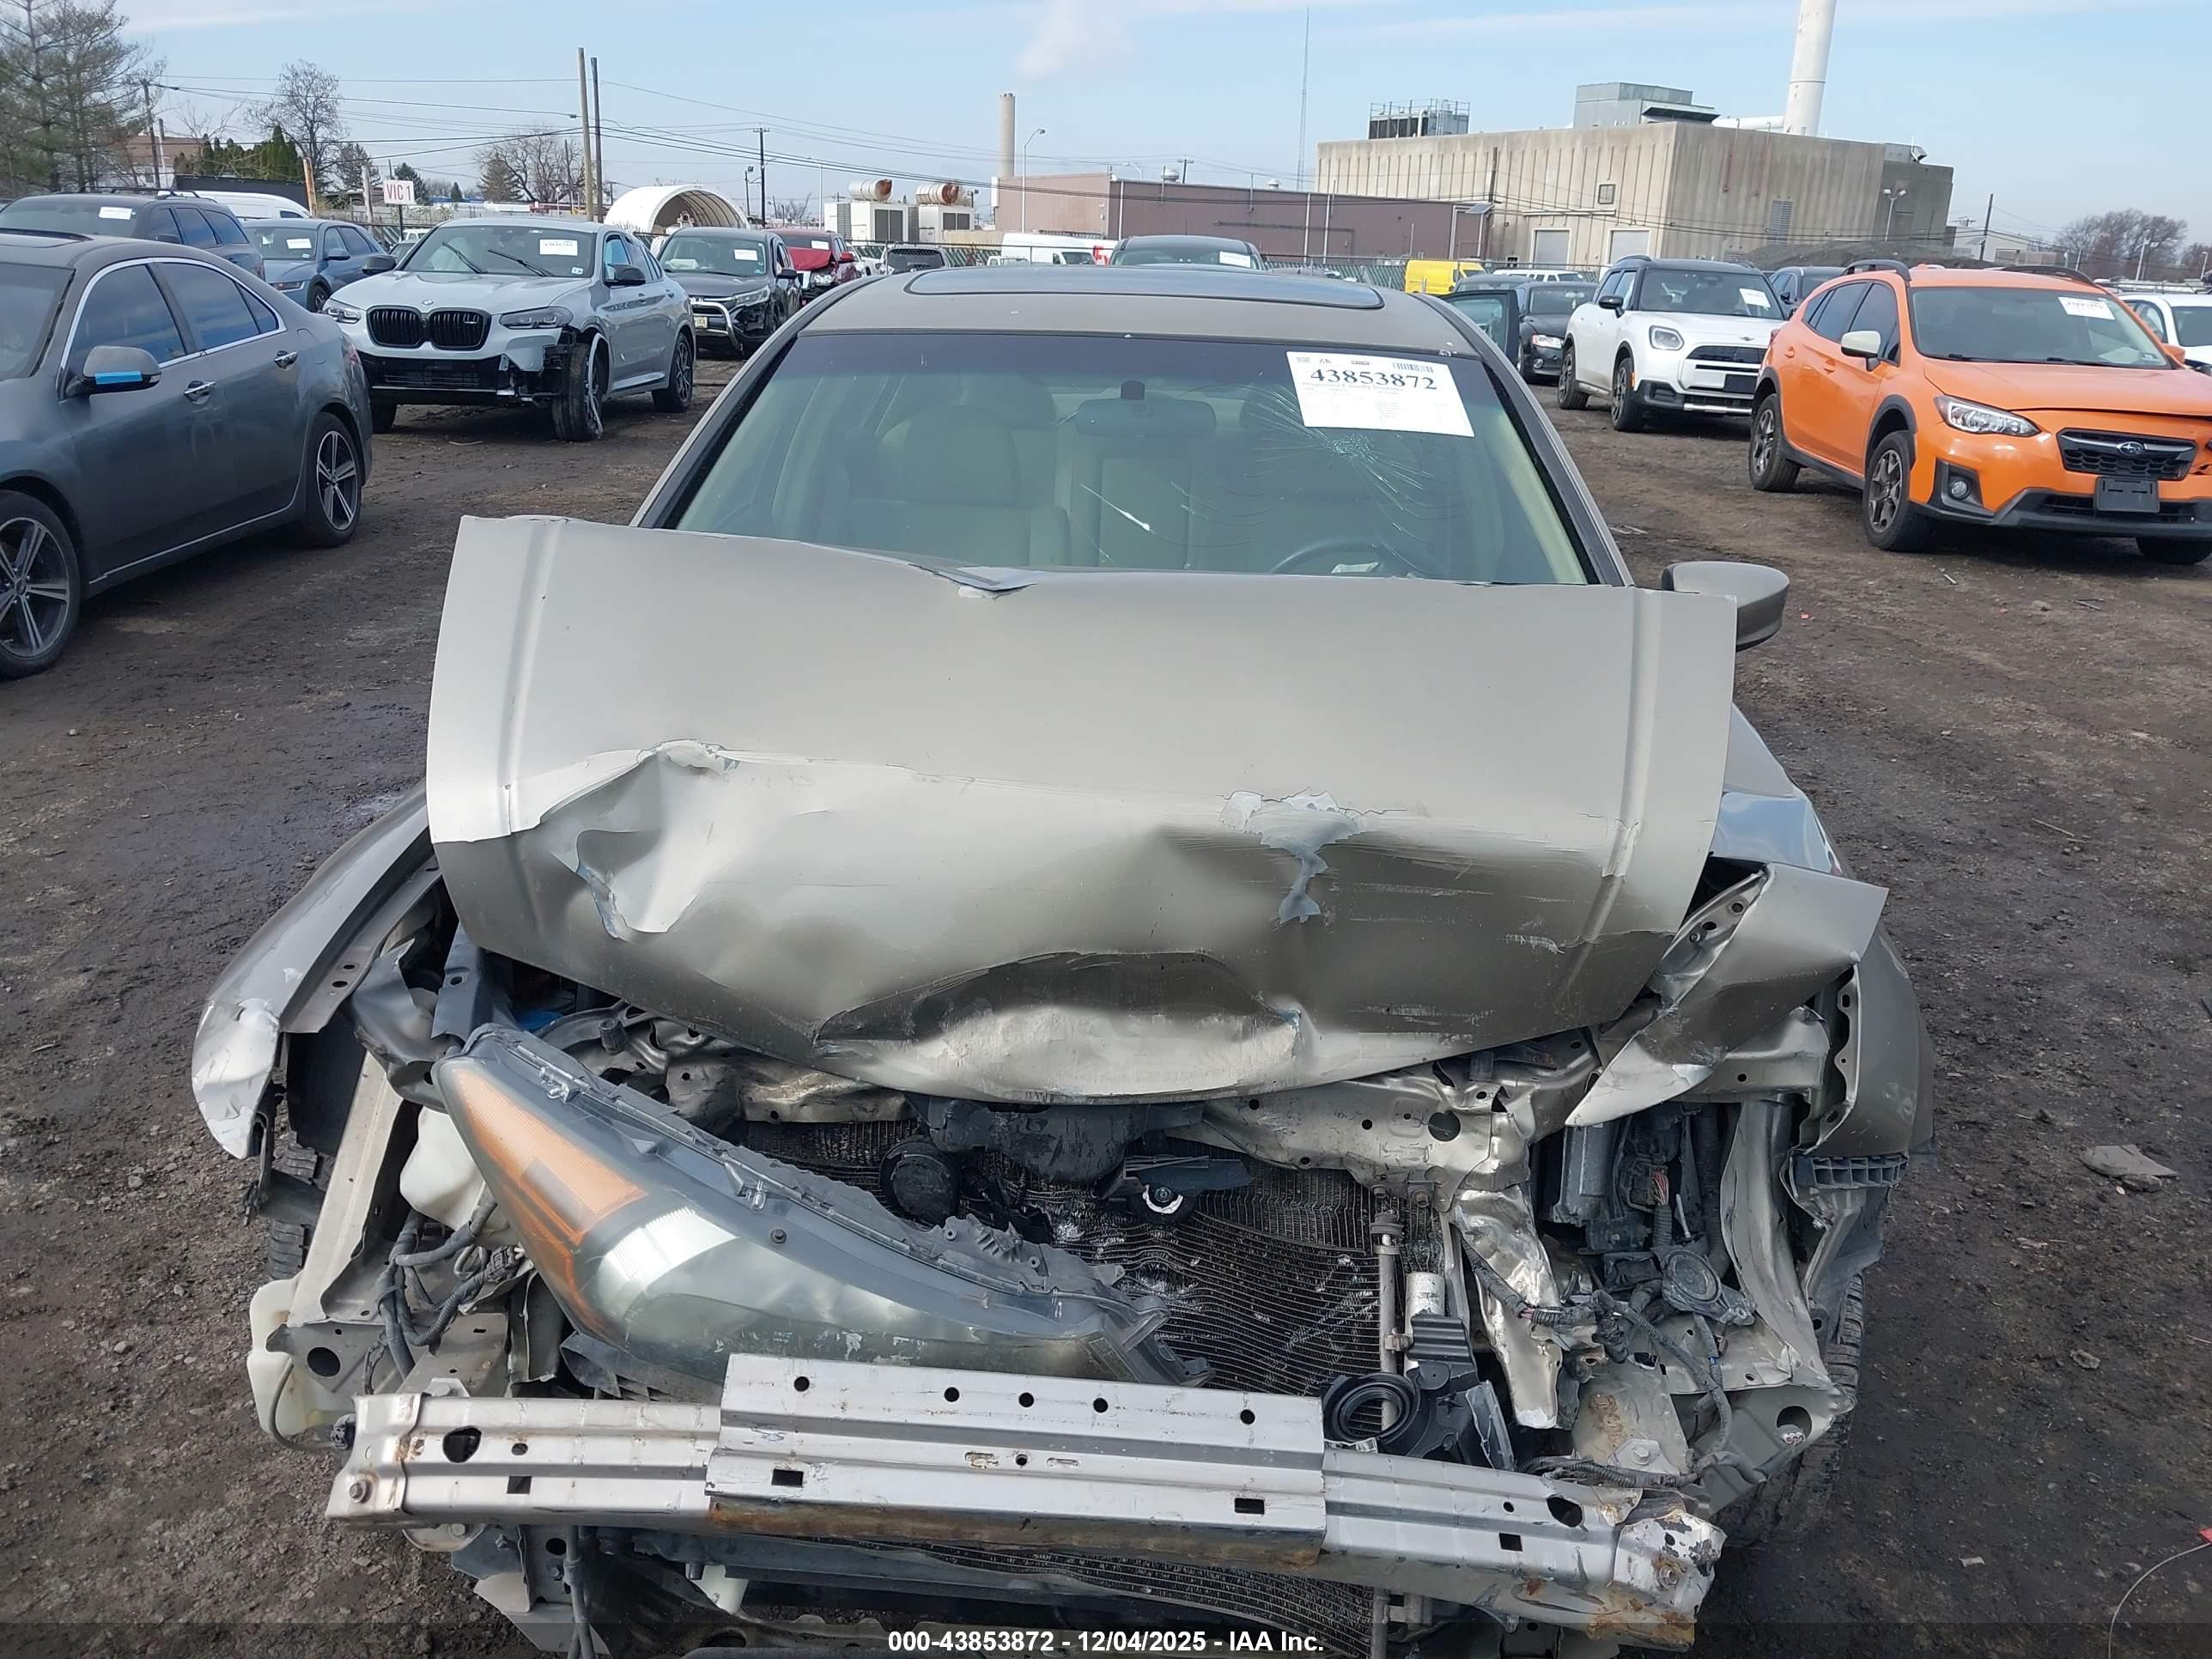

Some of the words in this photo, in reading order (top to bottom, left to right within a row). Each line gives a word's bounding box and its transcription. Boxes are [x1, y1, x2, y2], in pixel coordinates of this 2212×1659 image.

[386, 184, 404, 200] VIC
[406, 185, 411, 201] 1
[1310, 368, 1437, 390] 43853872
